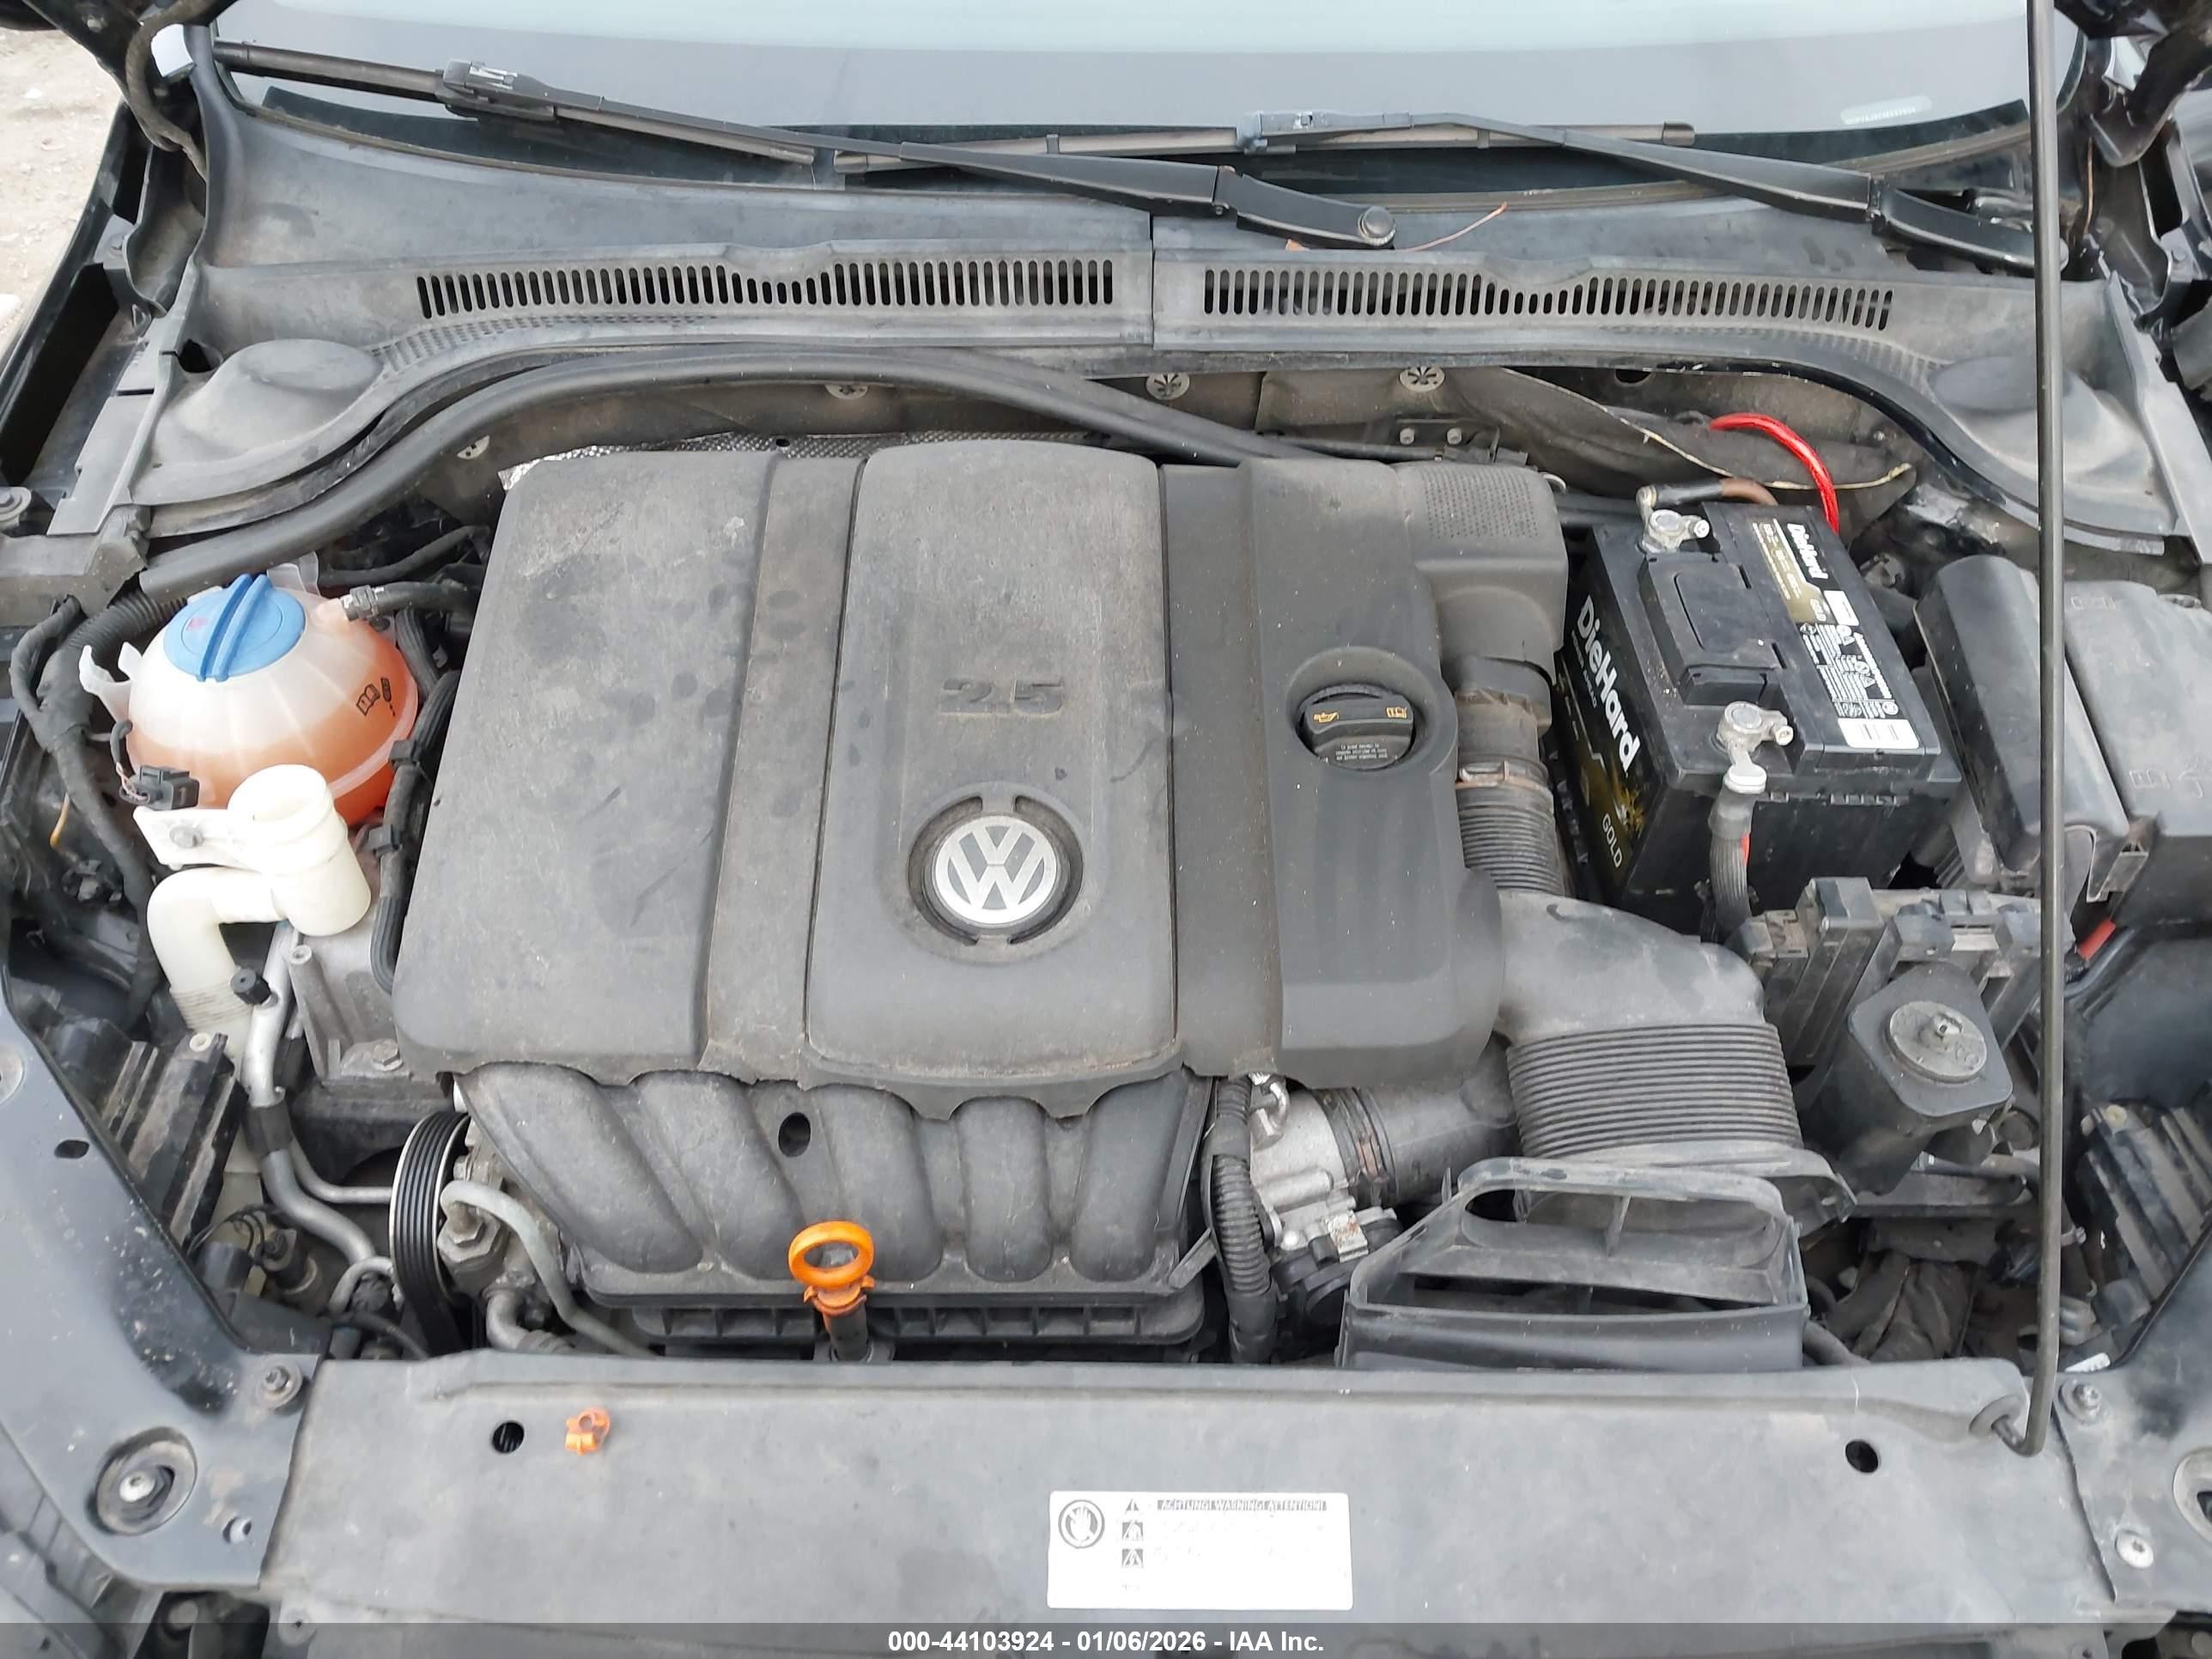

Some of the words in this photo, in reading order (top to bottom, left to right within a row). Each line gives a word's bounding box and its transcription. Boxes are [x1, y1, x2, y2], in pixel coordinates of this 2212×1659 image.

[1787, 523, 1829, 580] DieHard
[942, 678, 1064, 715] 2.5
[1577, 595, 1641, 773] DieHard
[1602, 813, 1623, 868] GOLD
